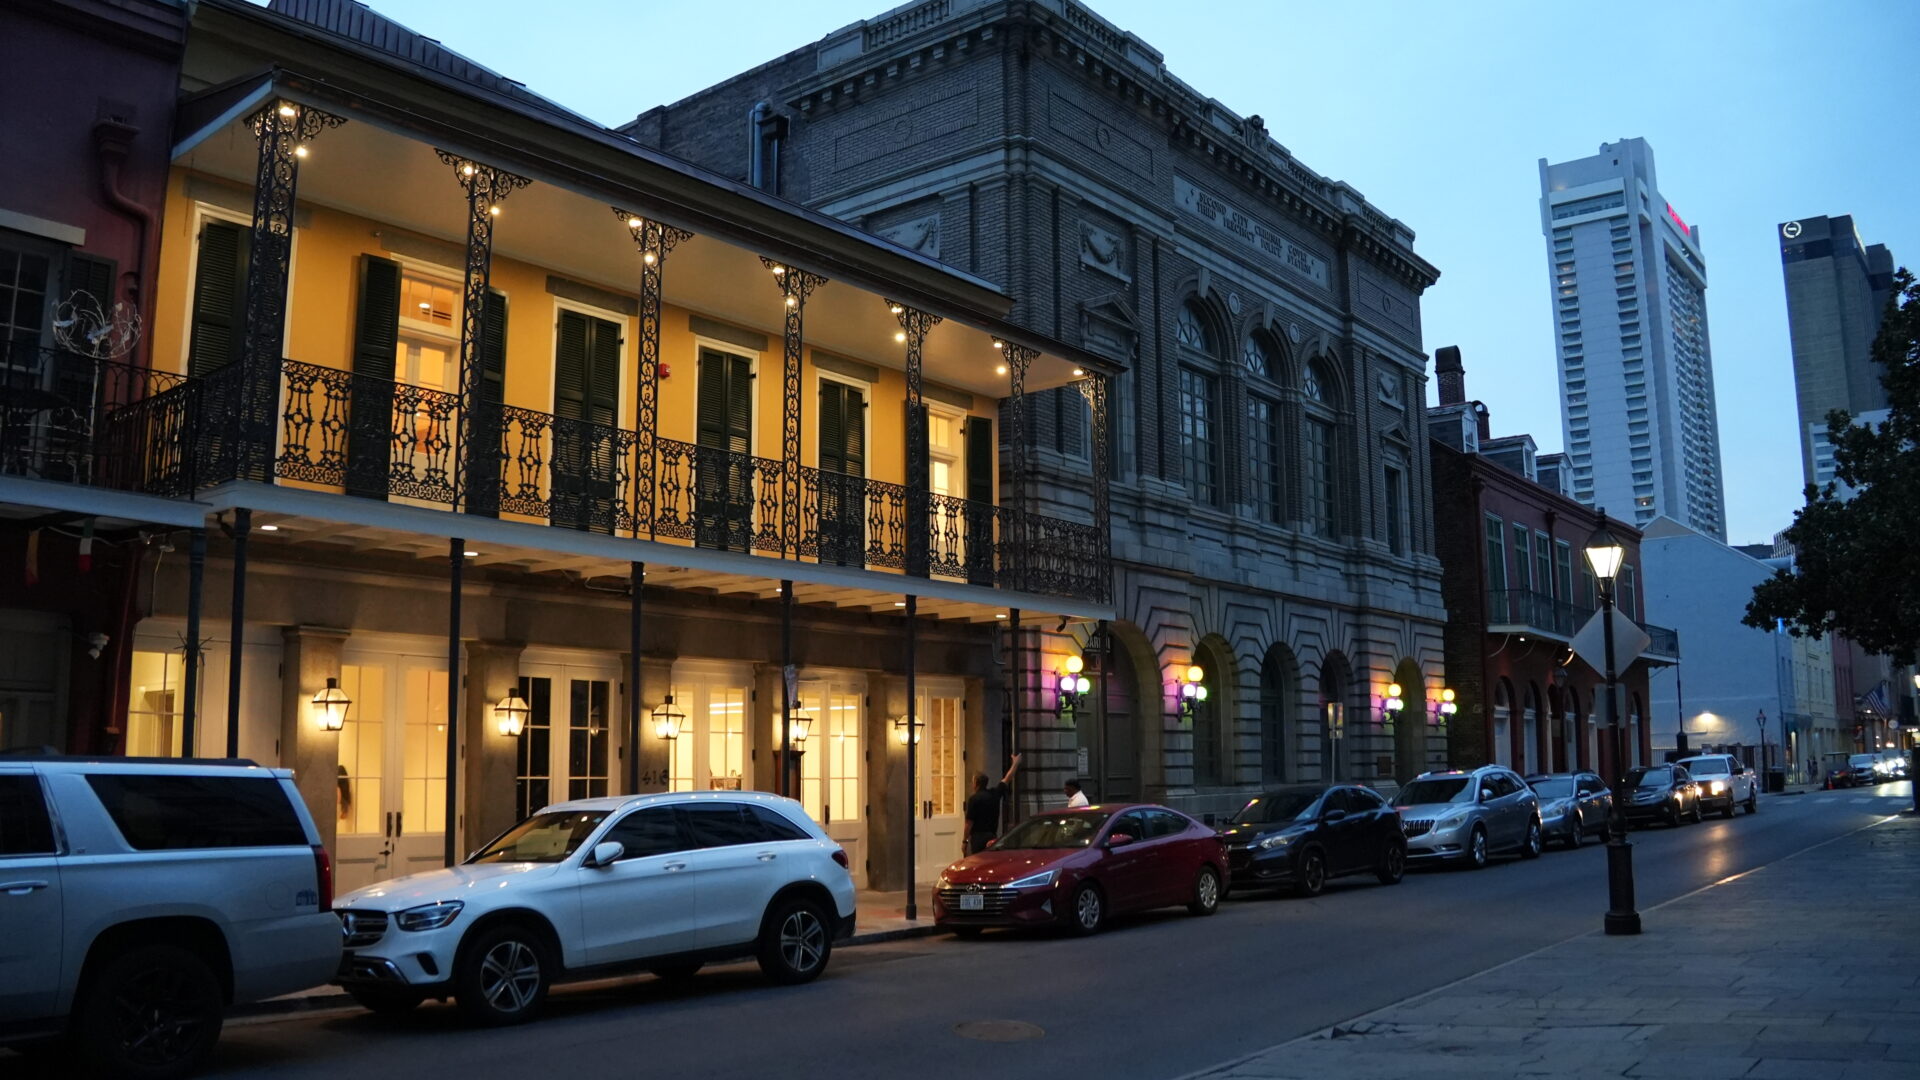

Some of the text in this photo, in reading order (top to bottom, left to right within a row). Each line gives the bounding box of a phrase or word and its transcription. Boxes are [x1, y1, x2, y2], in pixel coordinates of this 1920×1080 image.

[1196, 201, 1311, 275] THIRD PRECINCT POLICE STATION
[1199, 191, 1227, 215] SECOND
[1232, 211, 1249, 229] CITY
[1254, 225, 1283, 249] CRIMINAL
